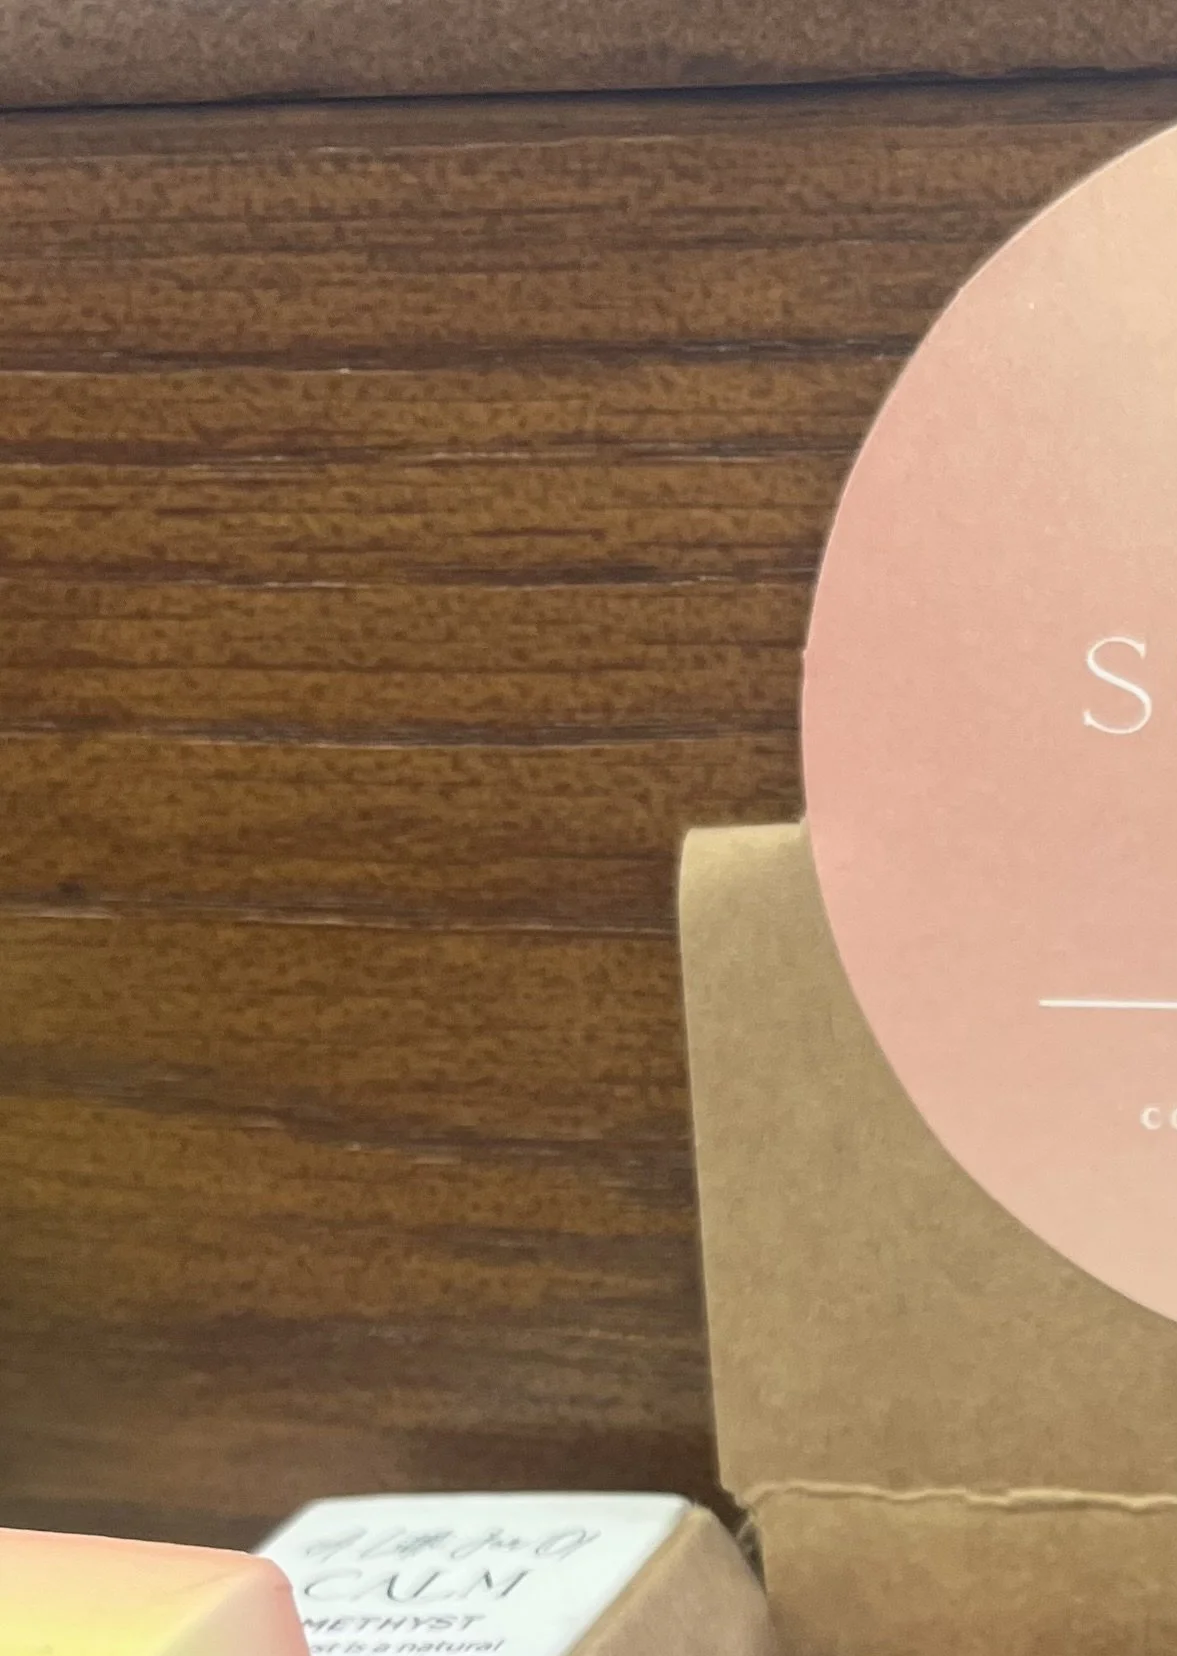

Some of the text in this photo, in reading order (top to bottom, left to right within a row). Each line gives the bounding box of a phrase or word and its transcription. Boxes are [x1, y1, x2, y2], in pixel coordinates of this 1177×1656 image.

[303, 1568, 530, 1602] CALM
[302, 1613, 486, 1632] METHYST
[396, 1638, 505, 1654] natural
